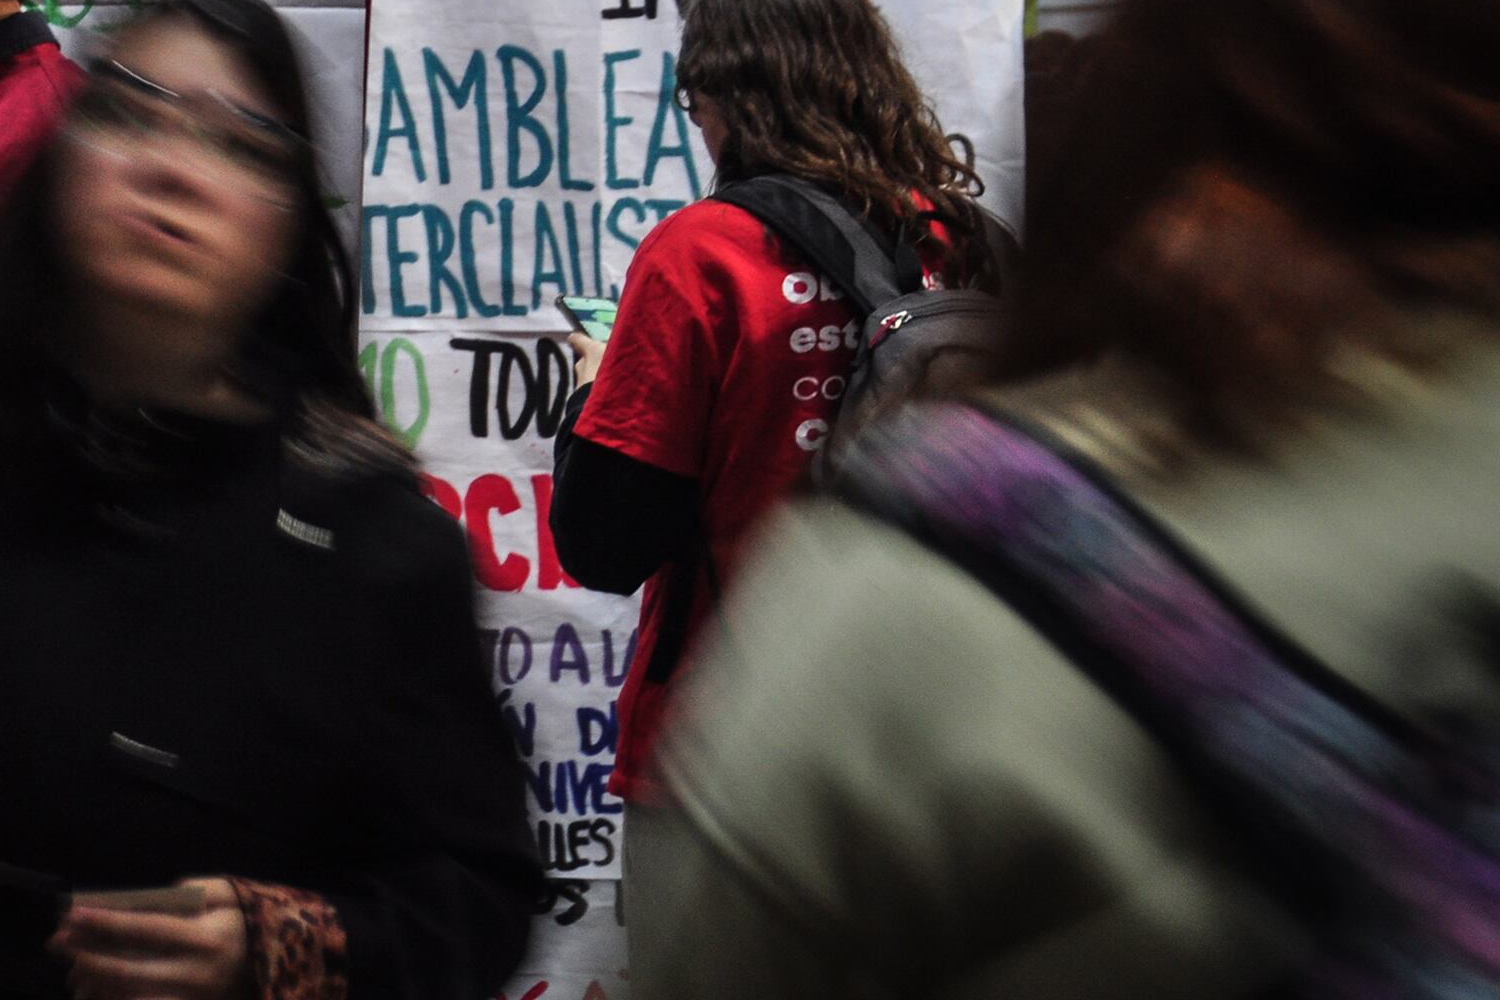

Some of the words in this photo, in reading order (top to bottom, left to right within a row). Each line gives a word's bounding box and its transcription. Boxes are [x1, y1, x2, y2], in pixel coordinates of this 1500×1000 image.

[370, 45, 700, 200] AMBLEA
[449, 337, 578, 440] TOD
[550, 621, 591, 684] A
